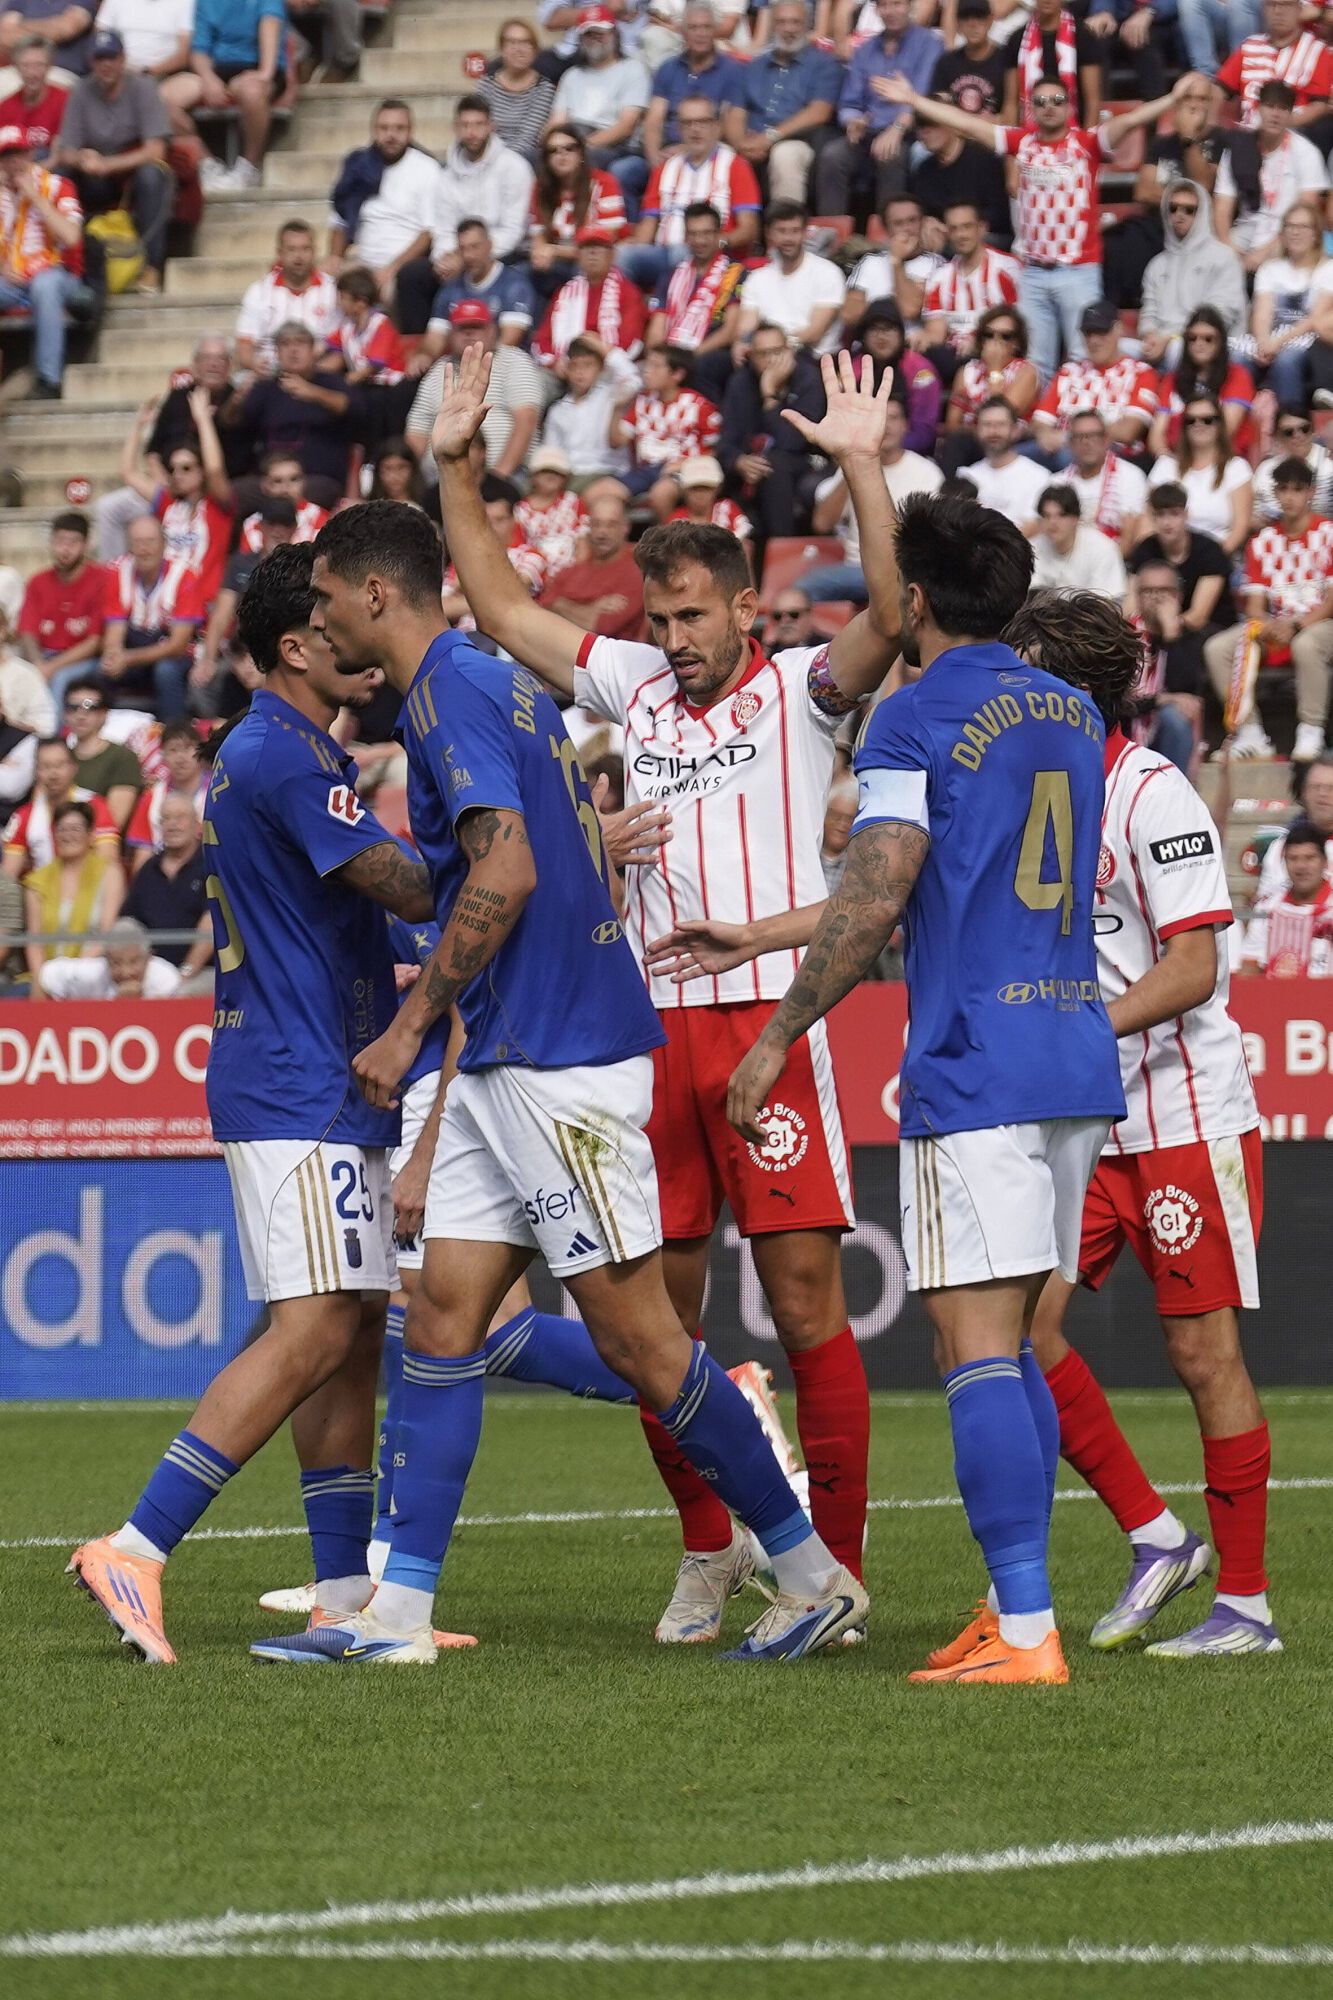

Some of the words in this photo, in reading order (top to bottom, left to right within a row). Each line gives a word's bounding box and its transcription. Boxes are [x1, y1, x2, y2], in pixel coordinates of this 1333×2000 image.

[951, 693, 1023, 772] DAVID
[633, 743, 757, 779] ETIHAD
[643, 776, 723, 798] AIRWAYS
[1013, 770, 1074, 936] 4
[1158, 835, 1206, 861] HYLO
[0, 1025, 160, 1086] DADO
[774, 1103, 806, 1131] Brava
[330, 1160, 375, 1223] 25
[1165, 1184, 1200, 1213] Brava
[1160, 1212, 1180, 1231] G!
[2, 1183, 225, 1349] da
